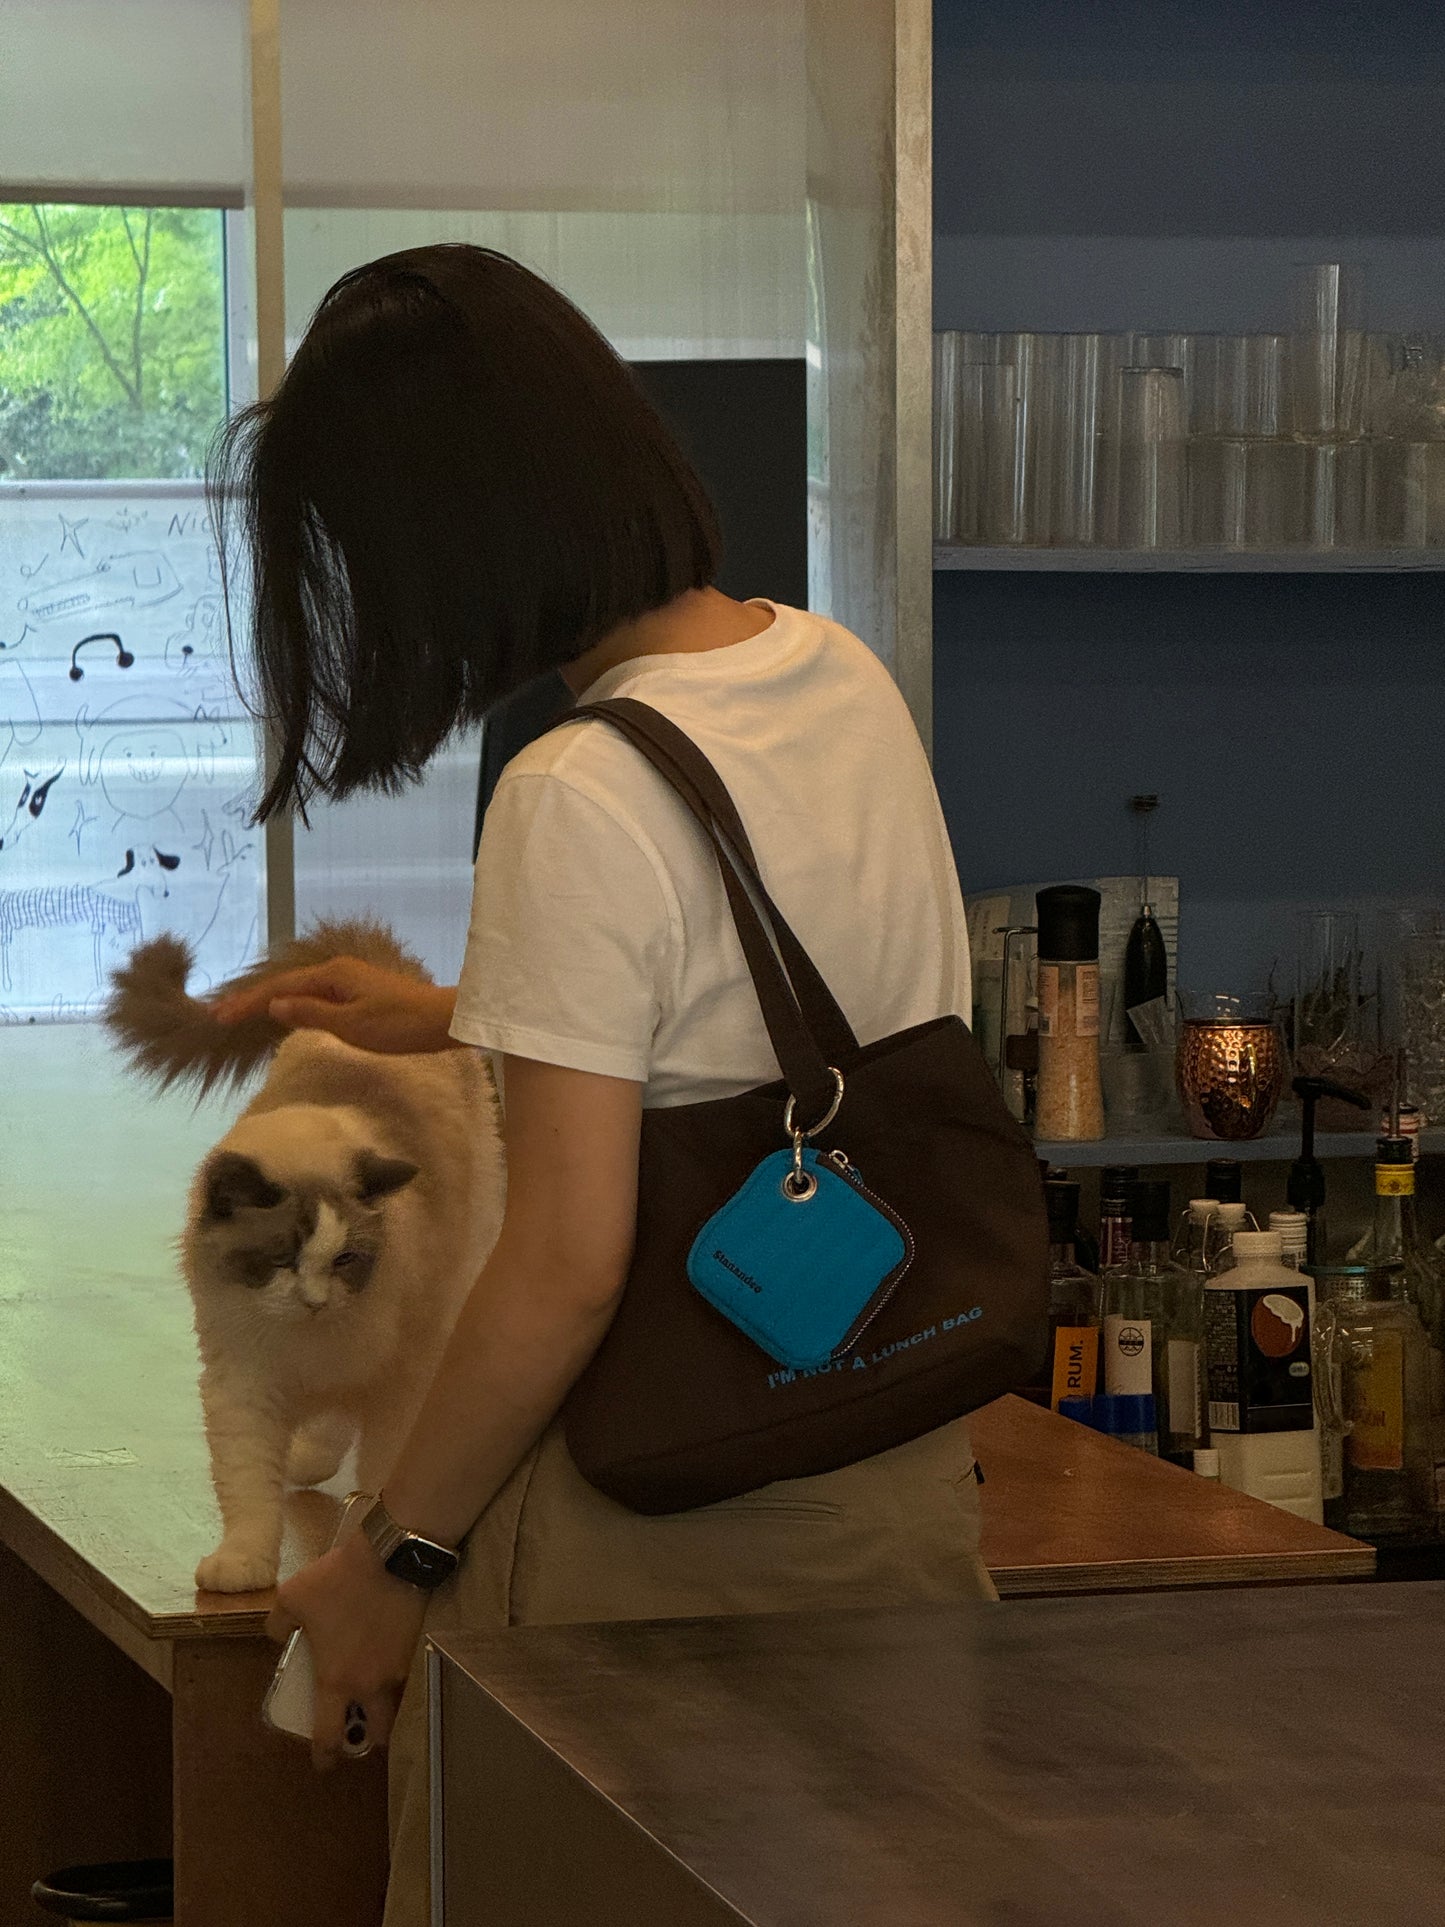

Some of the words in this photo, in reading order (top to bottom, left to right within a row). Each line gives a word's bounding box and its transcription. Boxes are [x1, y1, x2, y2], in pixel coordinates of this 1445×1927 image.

[767, 1368, 797, 1389] I'M
[802, 1360, 847, 1379] NOT
[852, 1356, 867, 1371] A
[872, 1325, 937, 1364] LUNCH
[942, 1306, 984, 1332] BAG
[1067, 1339, 1084, 1388] RUM.
